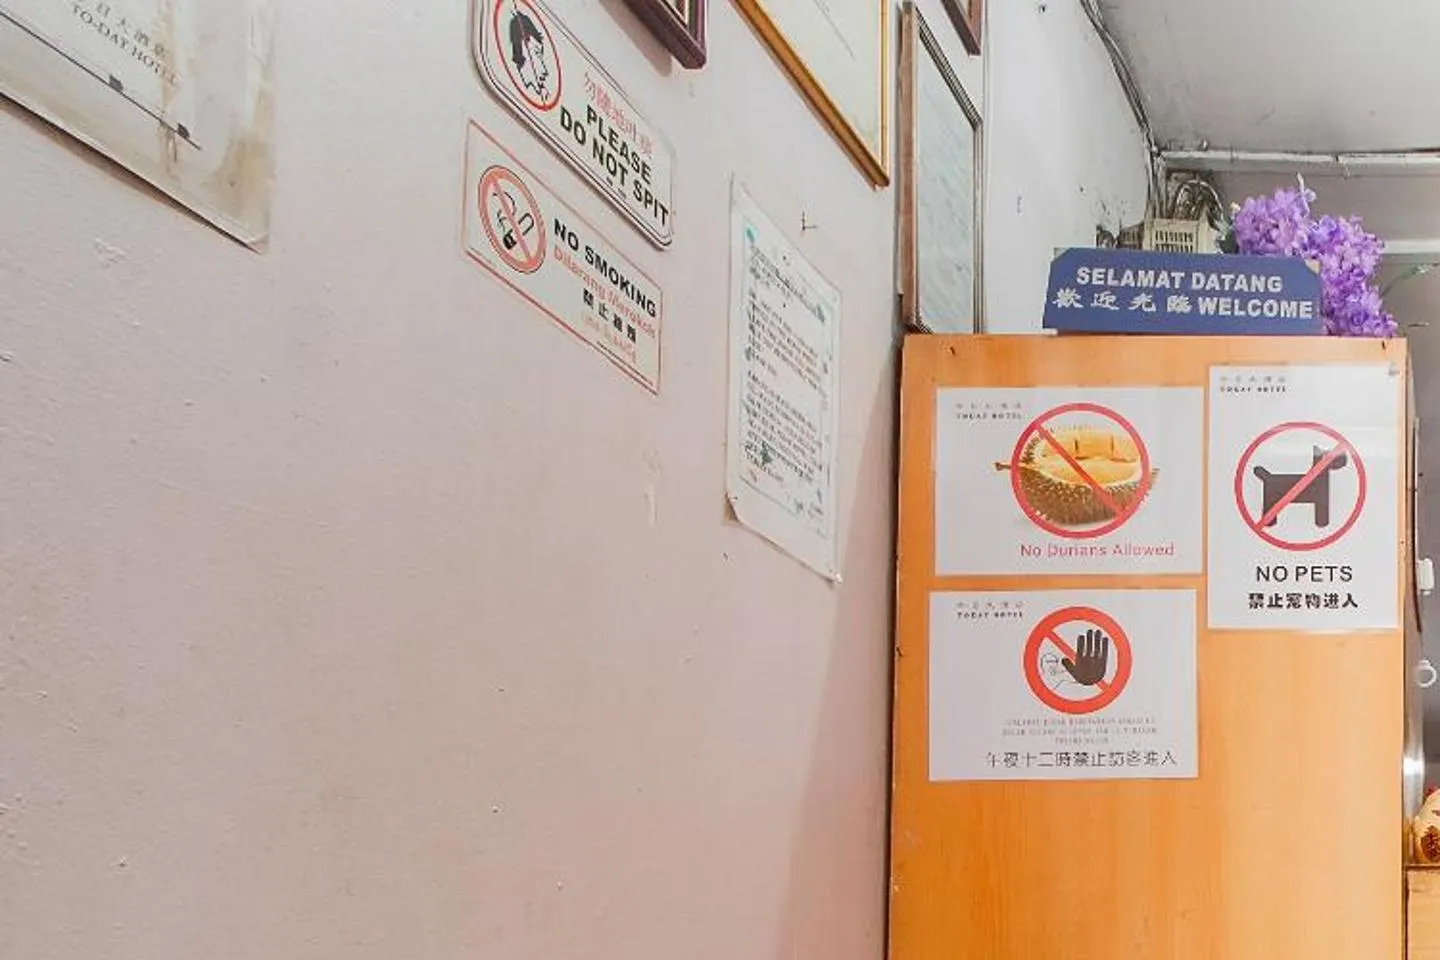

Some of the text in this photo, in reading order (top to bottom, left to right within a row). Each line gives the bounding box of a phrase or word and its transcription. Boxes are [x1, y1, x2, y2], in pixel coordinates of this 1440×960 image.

[586, 104, 652, 185] PLEASE
[560, 105, 587, 146] DO
[593, 137, 629, 187] NOT
[633, 179, 669, 227] SPIT
[554, 218, 657, 318] NO SMOKING
[1076, 266, 1283, 293] SELAMAT DATANG
[1199, 296, 1313, 320] WELCOME
[1020, 540, 1174, 557] No Durians Allowed
[1255, 565, 1353, 582] NO PETS
